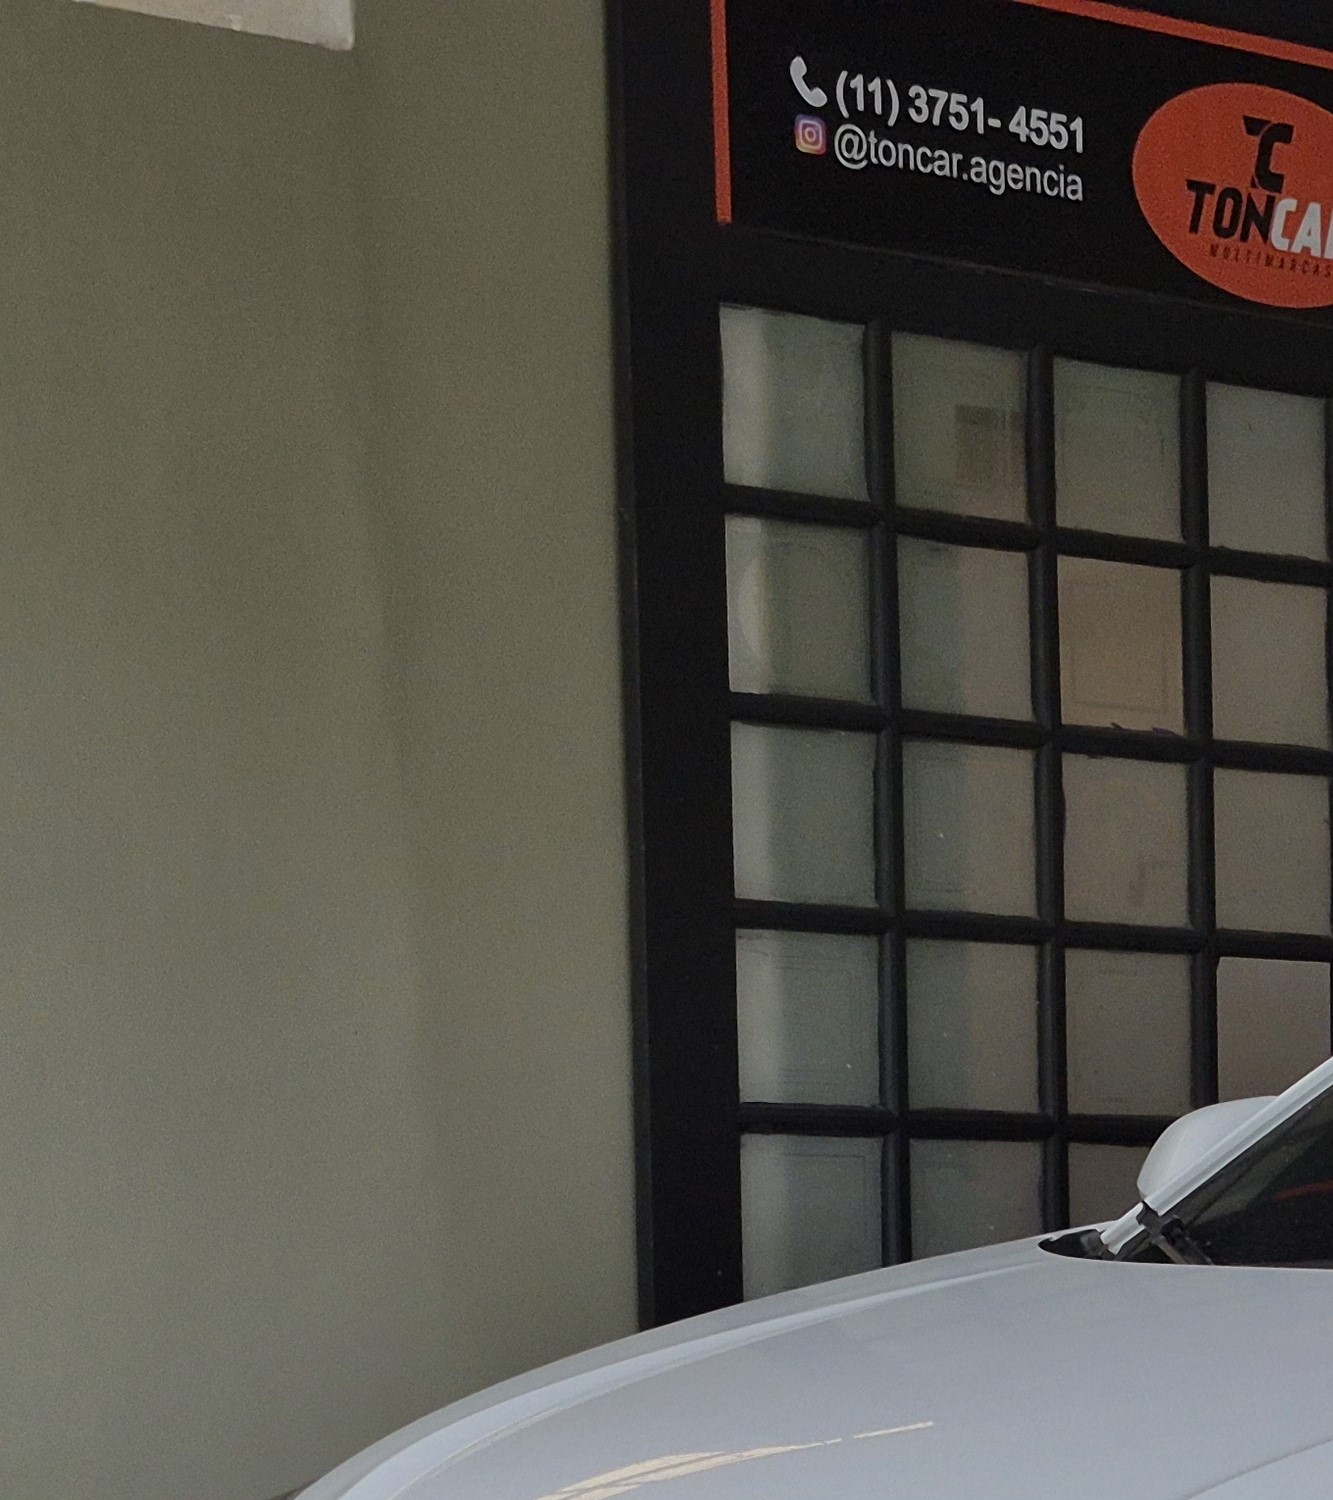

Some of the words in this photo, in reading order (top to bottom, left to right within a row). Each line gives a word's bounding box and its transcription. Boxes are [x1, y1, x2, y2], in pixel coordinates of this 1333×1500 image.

[836, 70, 900, 127] (11)
[1008, 105, 1084, 153] 4551
[834, 123, 1084, 201] @toncar.agencia
[1209, 243, 1333, 278] MULTIMARCAS
